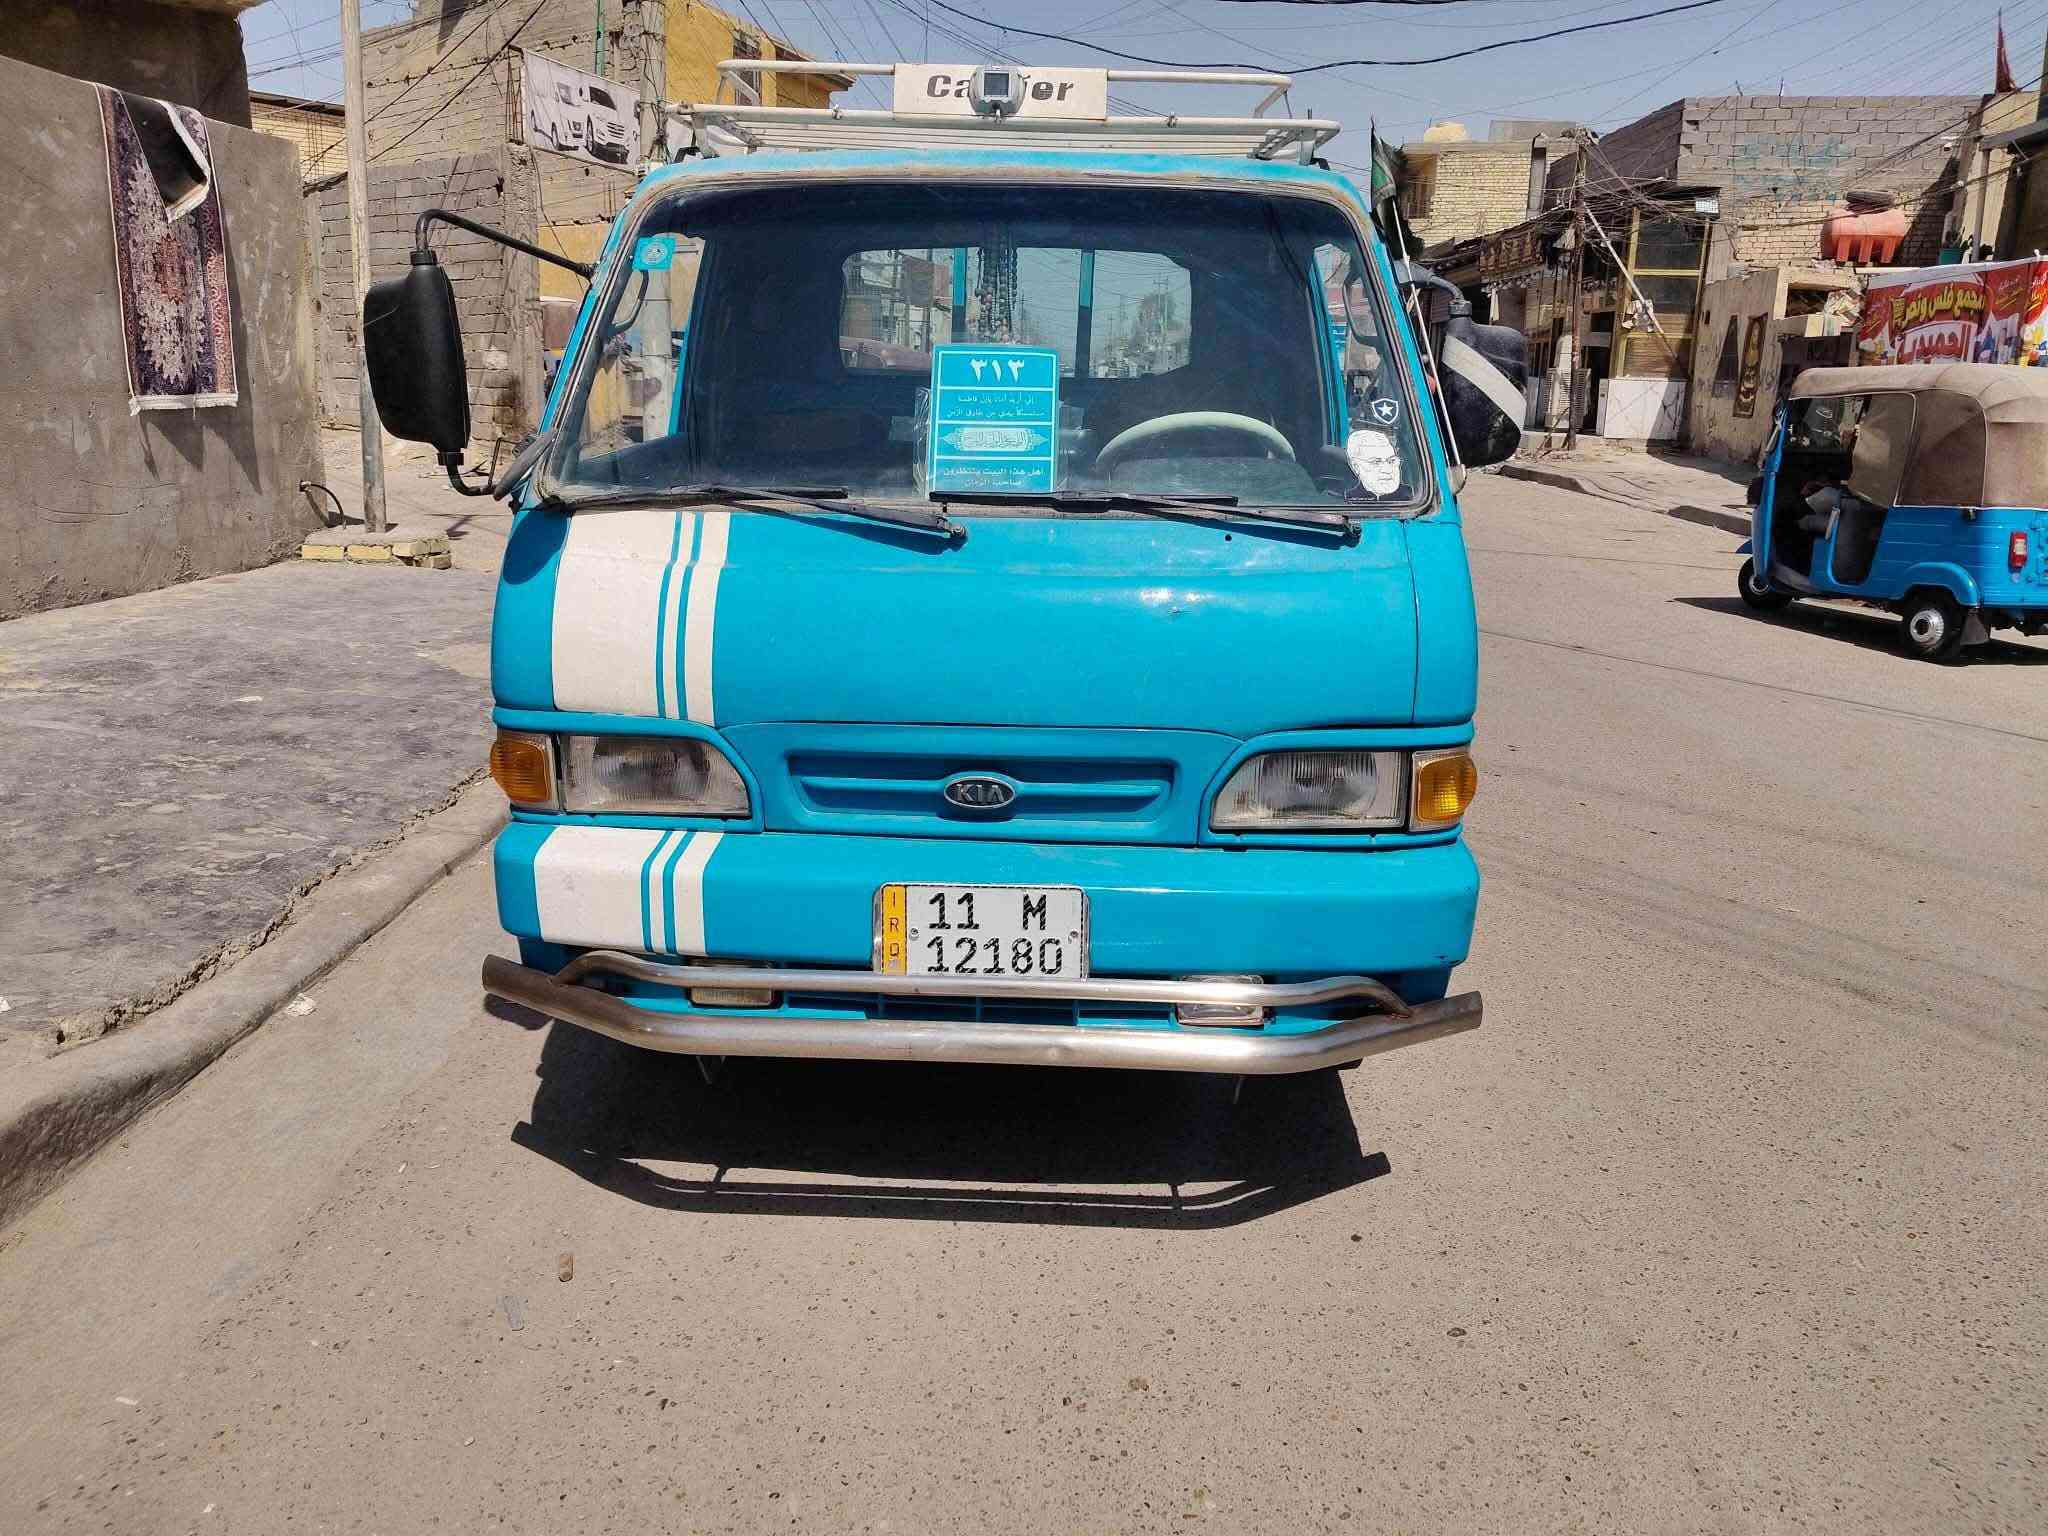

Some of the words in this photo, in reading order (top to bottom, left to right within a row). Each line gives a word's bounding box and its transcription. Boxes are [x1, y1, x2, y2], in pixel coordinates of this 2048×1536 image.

[926, 74, 1074, 101] Caier
[969, 358, 1025, 383] ٣١٣
[955, 784, 1005, 802] KIA
[928, 892, 980, 930] 11
[1022, 893, 1047, 931] M
[927, 936, 1063, 975] 12180
